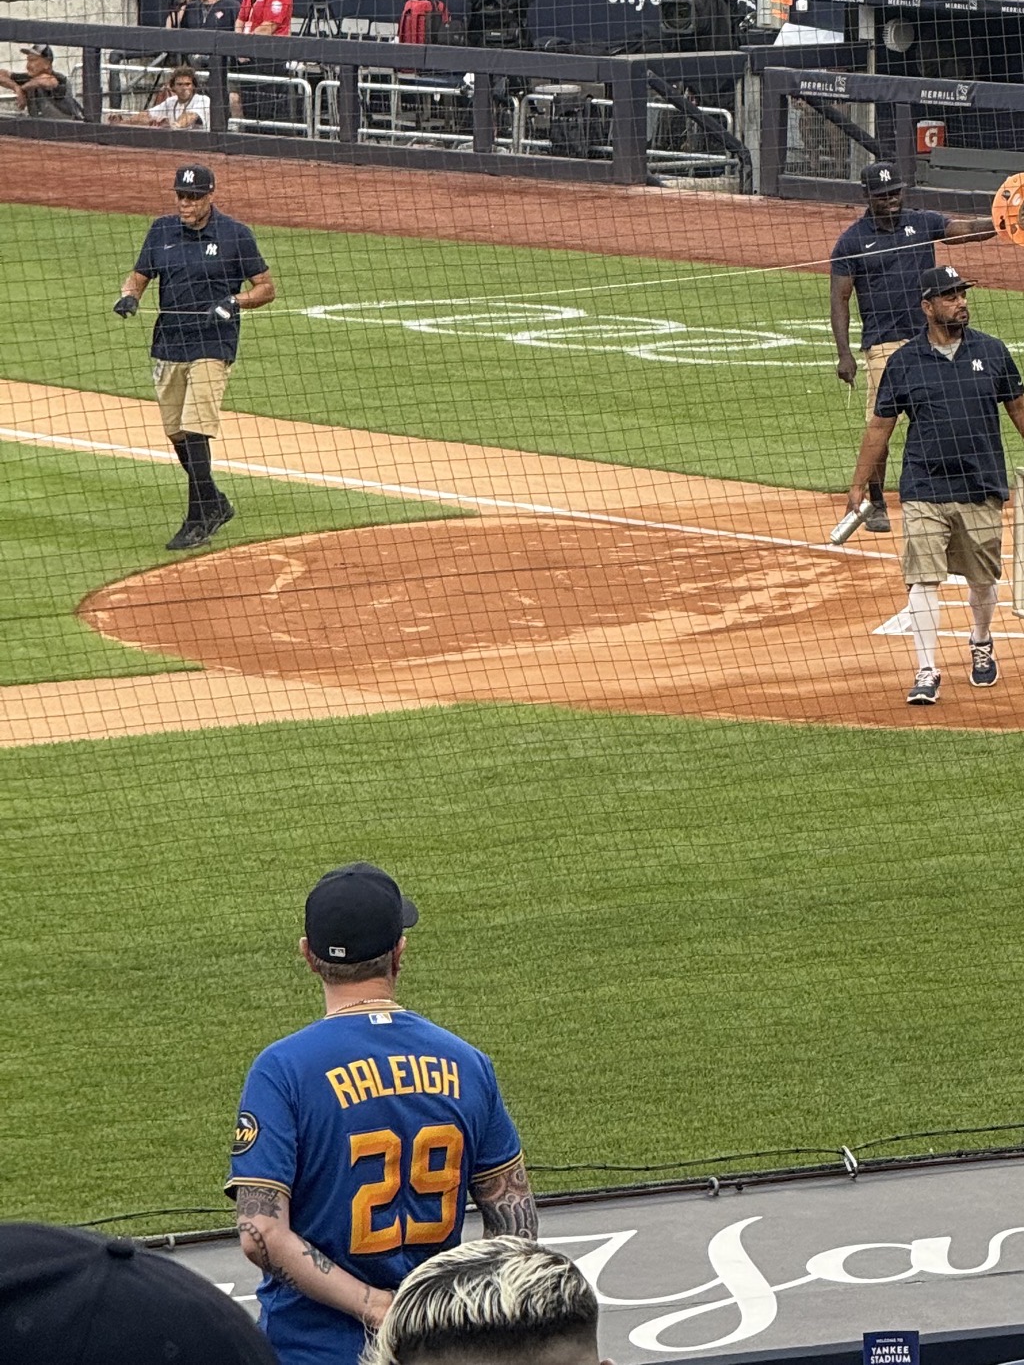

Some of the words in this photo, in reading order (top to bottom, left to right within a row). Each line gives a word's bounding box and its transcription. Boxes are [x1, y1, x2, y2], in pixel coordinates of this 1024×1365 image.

[800, 81, 832, 91] MERRILL
[921, 90, 954, 100] MERRILL
[924, 127, 938, 148] G
[182, 169, 195, 184] NY
[878, 168, 892, 183] NY
[903, 225, 917, 237] NY
[205, 243, 218, 256] NY
[971, 358, 984, 372] NY
[325, 1055, 460, 1110] RALEIGH
[348, 1124, 465, 1255] 29
[871, 1345, 910, 1355] YANKEE
[870, 1354, 911, 1365] STADIUM
